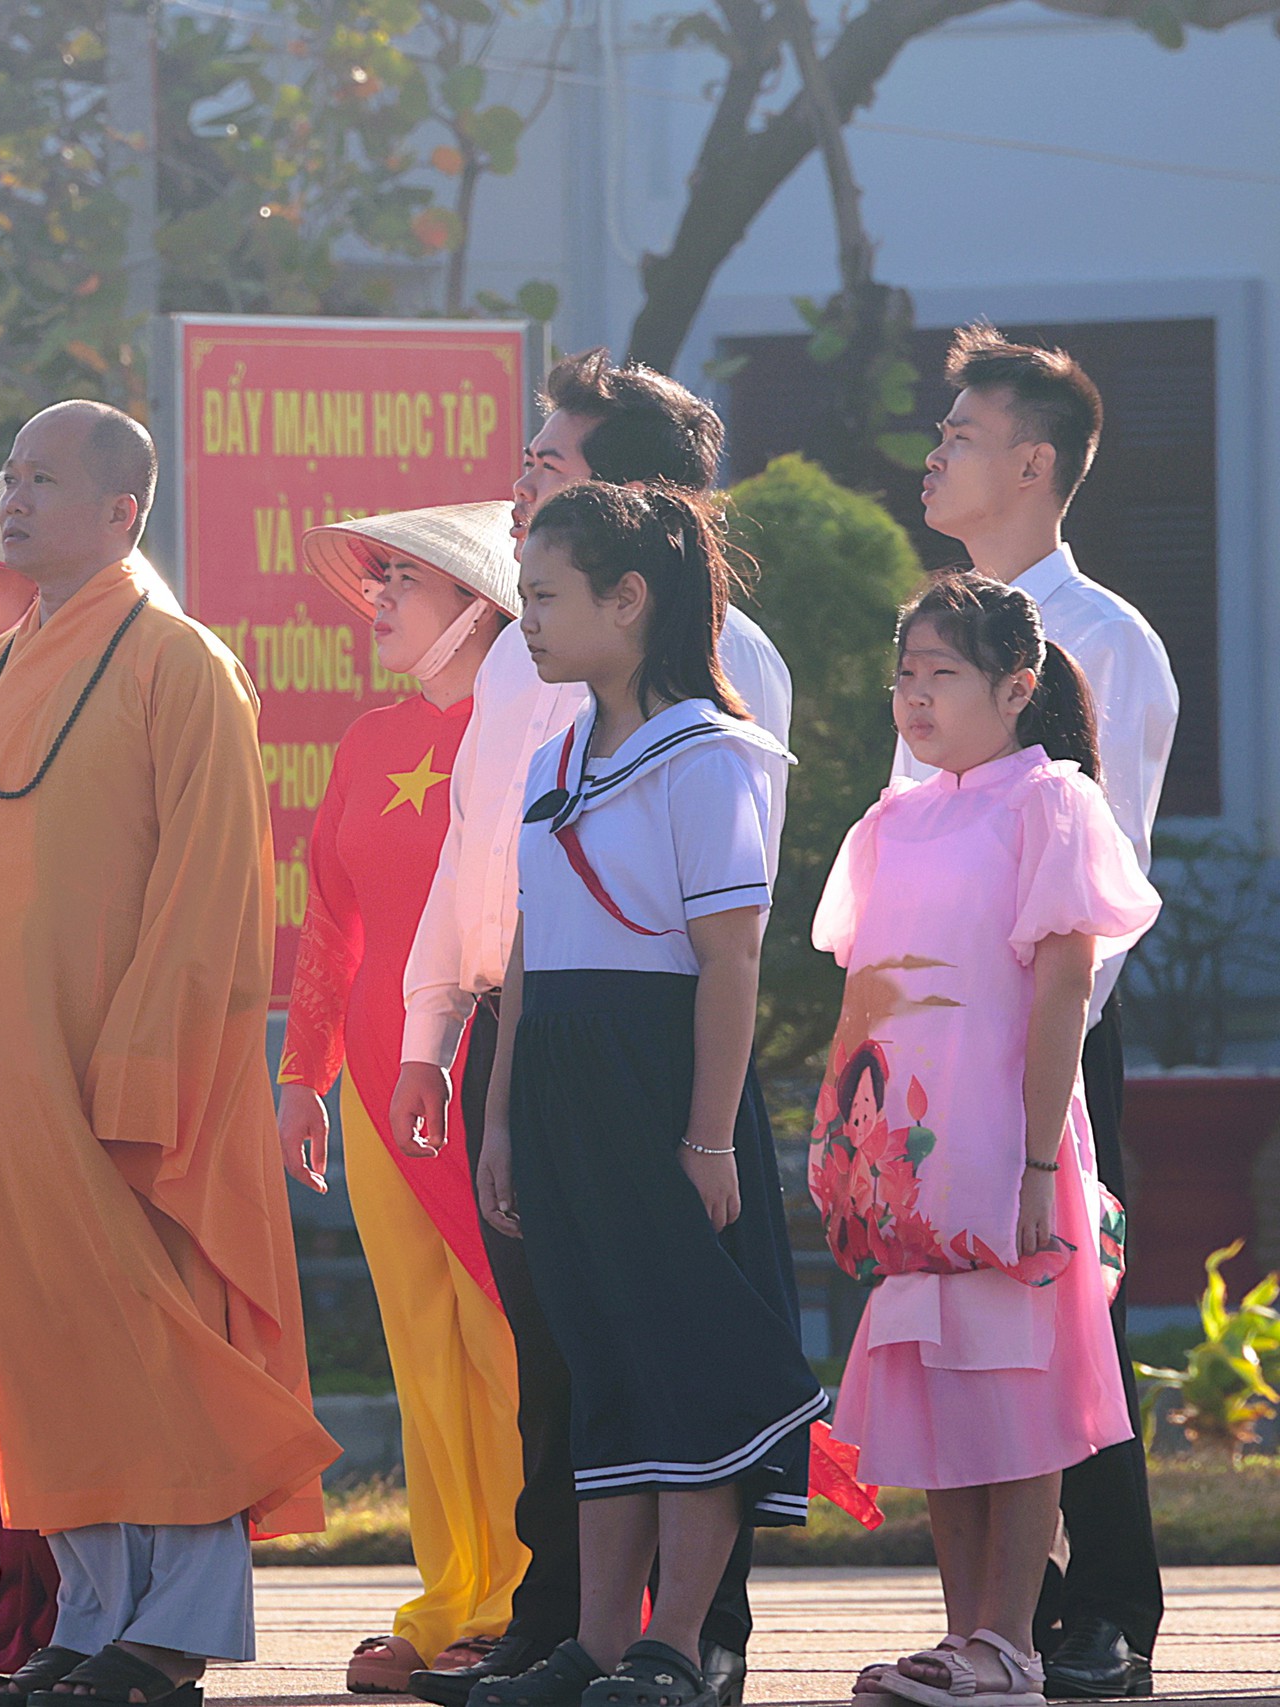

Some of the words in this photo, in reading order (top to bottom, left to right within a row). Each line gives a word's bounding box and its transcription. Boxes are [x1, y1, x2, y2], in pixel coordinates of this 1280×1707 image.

[204, 361, 262, 455] ĐẨY
[272, 389, 364, 473] MẠNH
[374, 390, 433, 474] HỌC
[441, 380, 497, 474] TẬP
[254, 493, 295, 574] VÀ
[253, 603, 363, 699] TƯỞNG,
